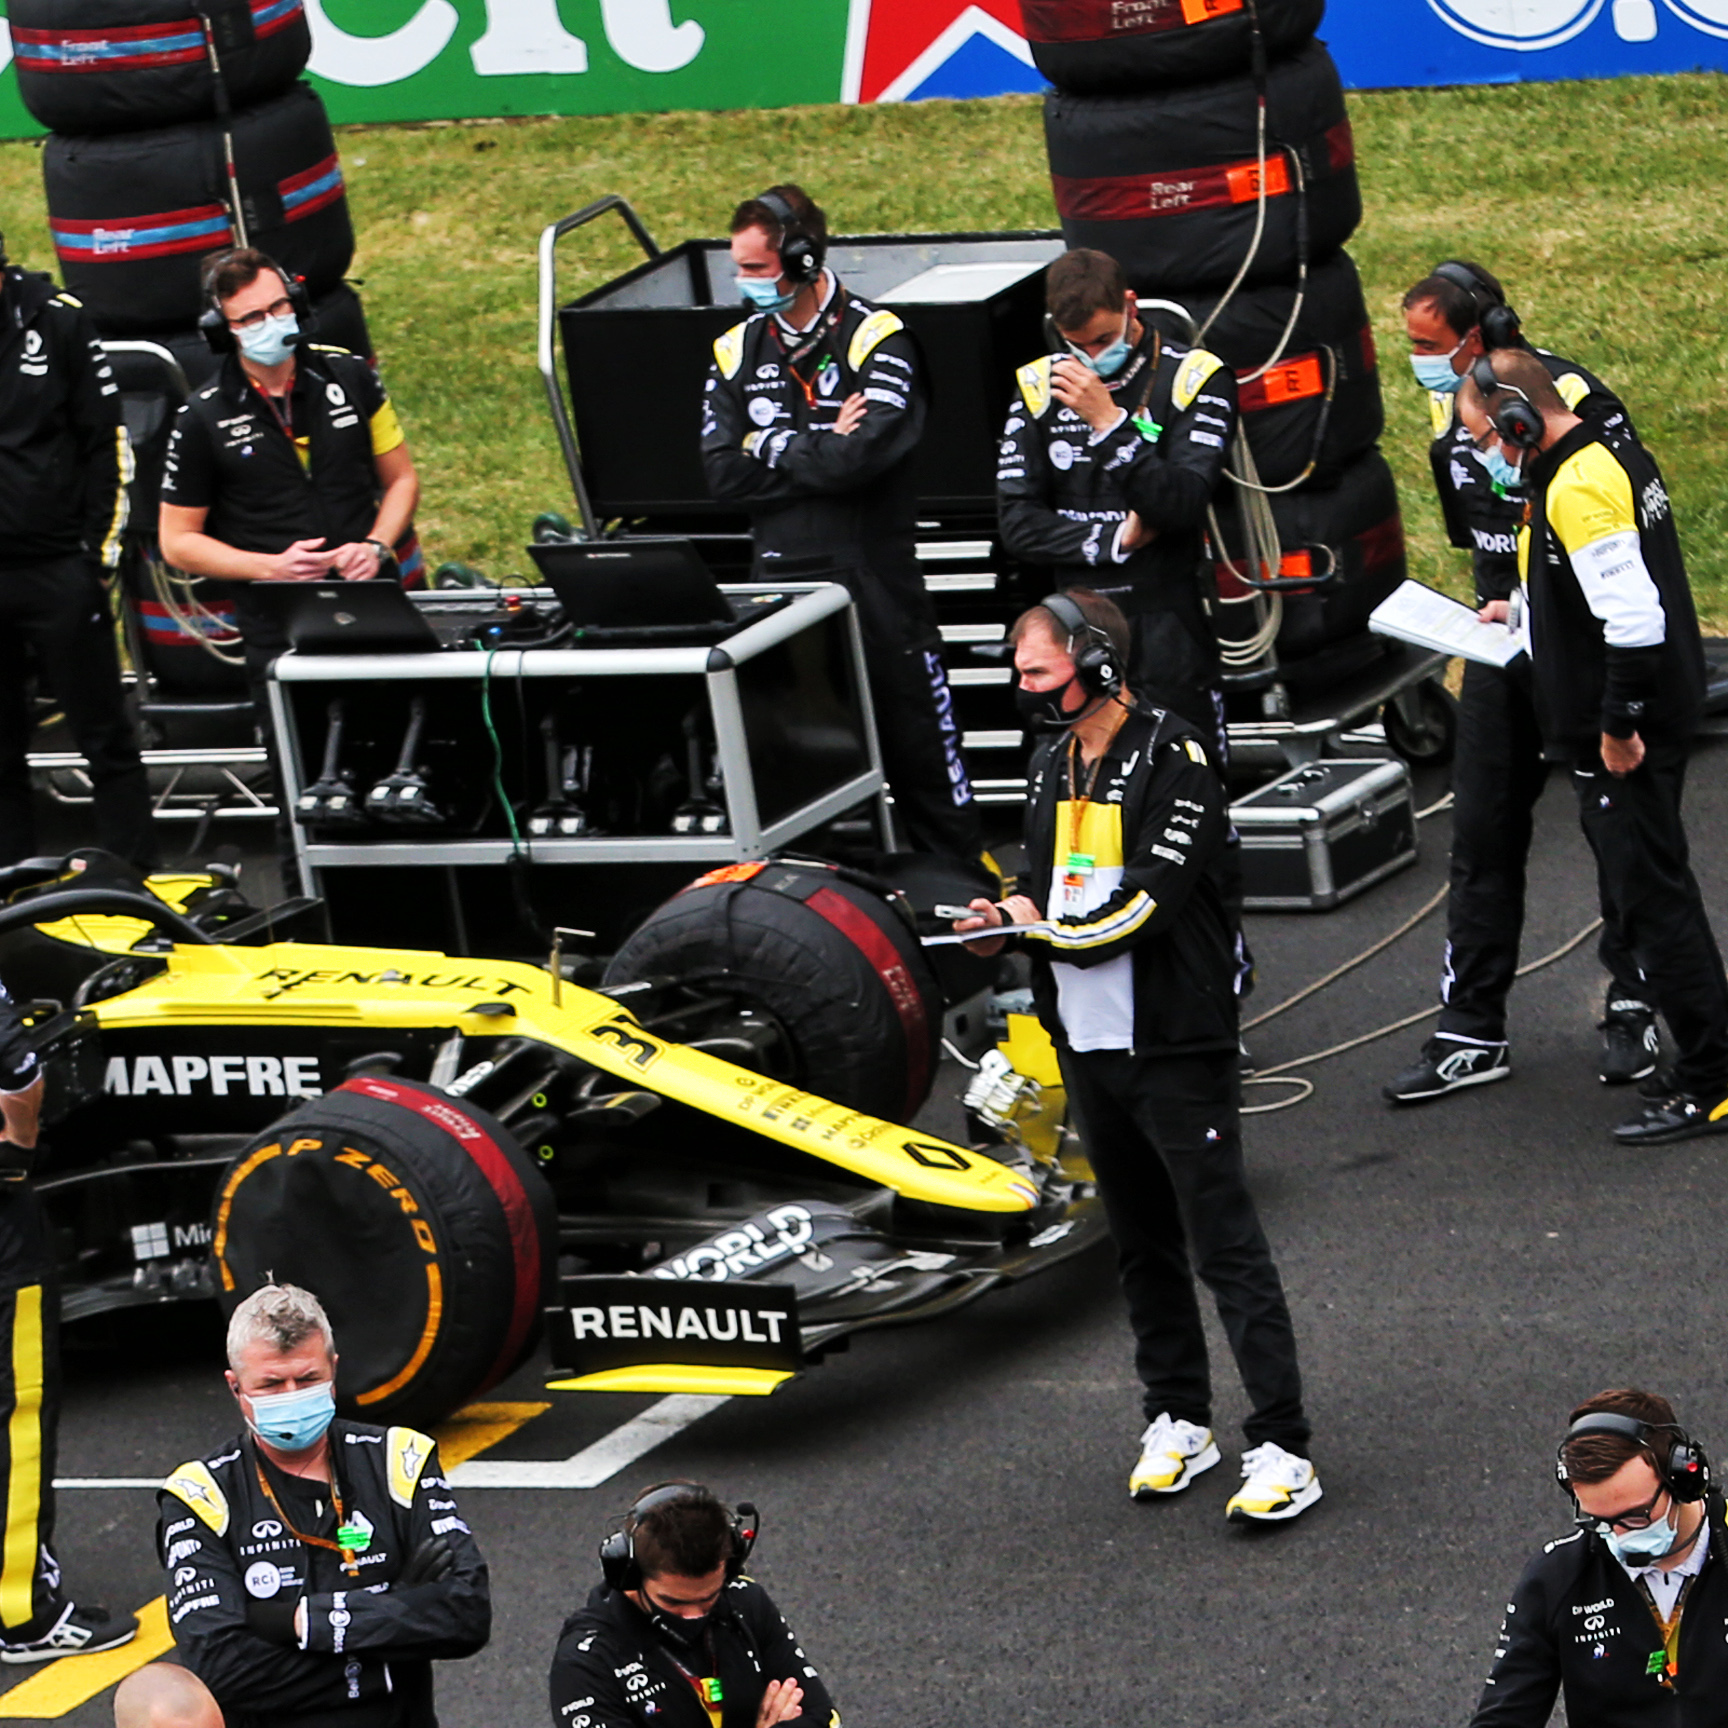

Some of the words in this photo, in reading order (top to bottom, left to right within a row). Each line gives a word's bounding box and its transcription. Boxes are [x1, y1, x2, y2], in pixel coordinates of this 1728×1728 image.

[1150, 180, 1195, 198] Rear
[1150, 194, 1192, 211] Left
[258, 966, 533, 998] RENAULT
[104, 1055, 324, 1098] MAPFRE
[287, 1137, 323, 1157] P
[333, 1146, 439, 1257] ZERO
[572, 1305, 788, 1344] RENAULT
[239, 1538, 303, 1557] INFINITI
